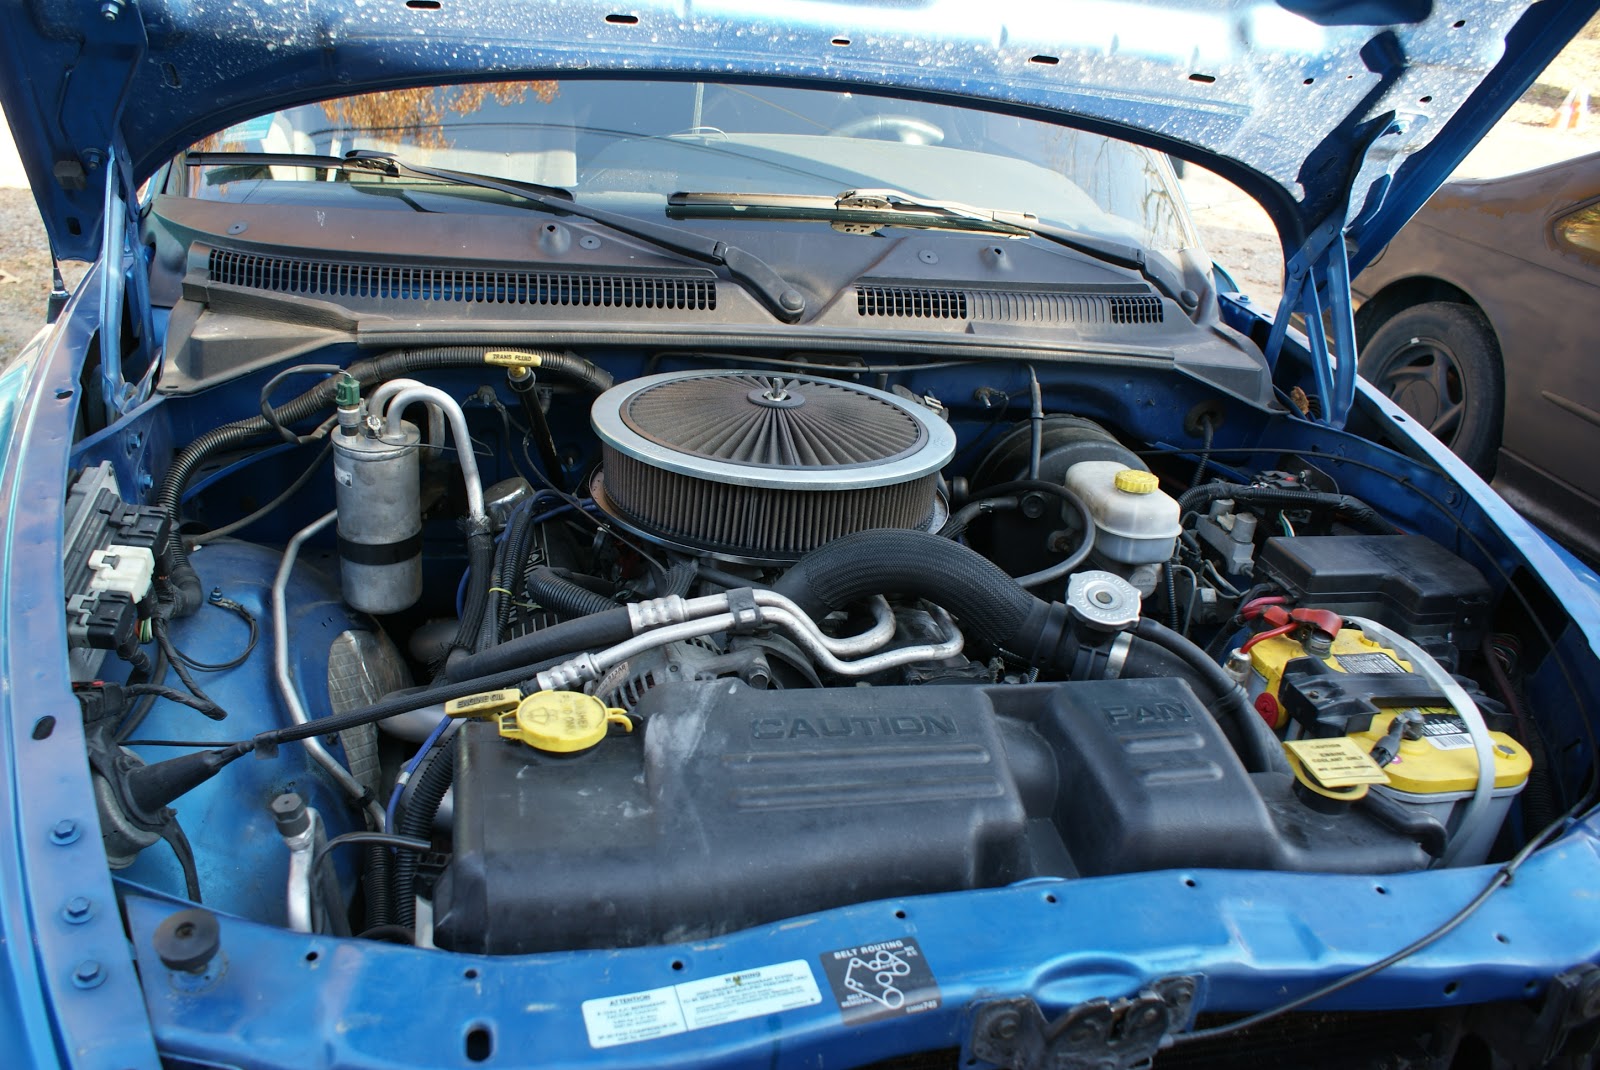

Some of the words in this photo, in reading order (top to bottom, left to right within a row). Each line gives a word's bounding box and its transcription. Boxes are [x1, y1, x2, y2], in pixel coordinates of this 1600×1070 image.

[457, 695, 490, 709] ENGINE
[490, 693, 506, 701] OIL
[751, 714, 959, 740] CAUTION
[1102, 701, 1194, 725] FAN
[833, 948, 858, 960] BELT
[860, 939, 904, 955] ROUTING
[609, 994, 651, 1007] ATTENTION
